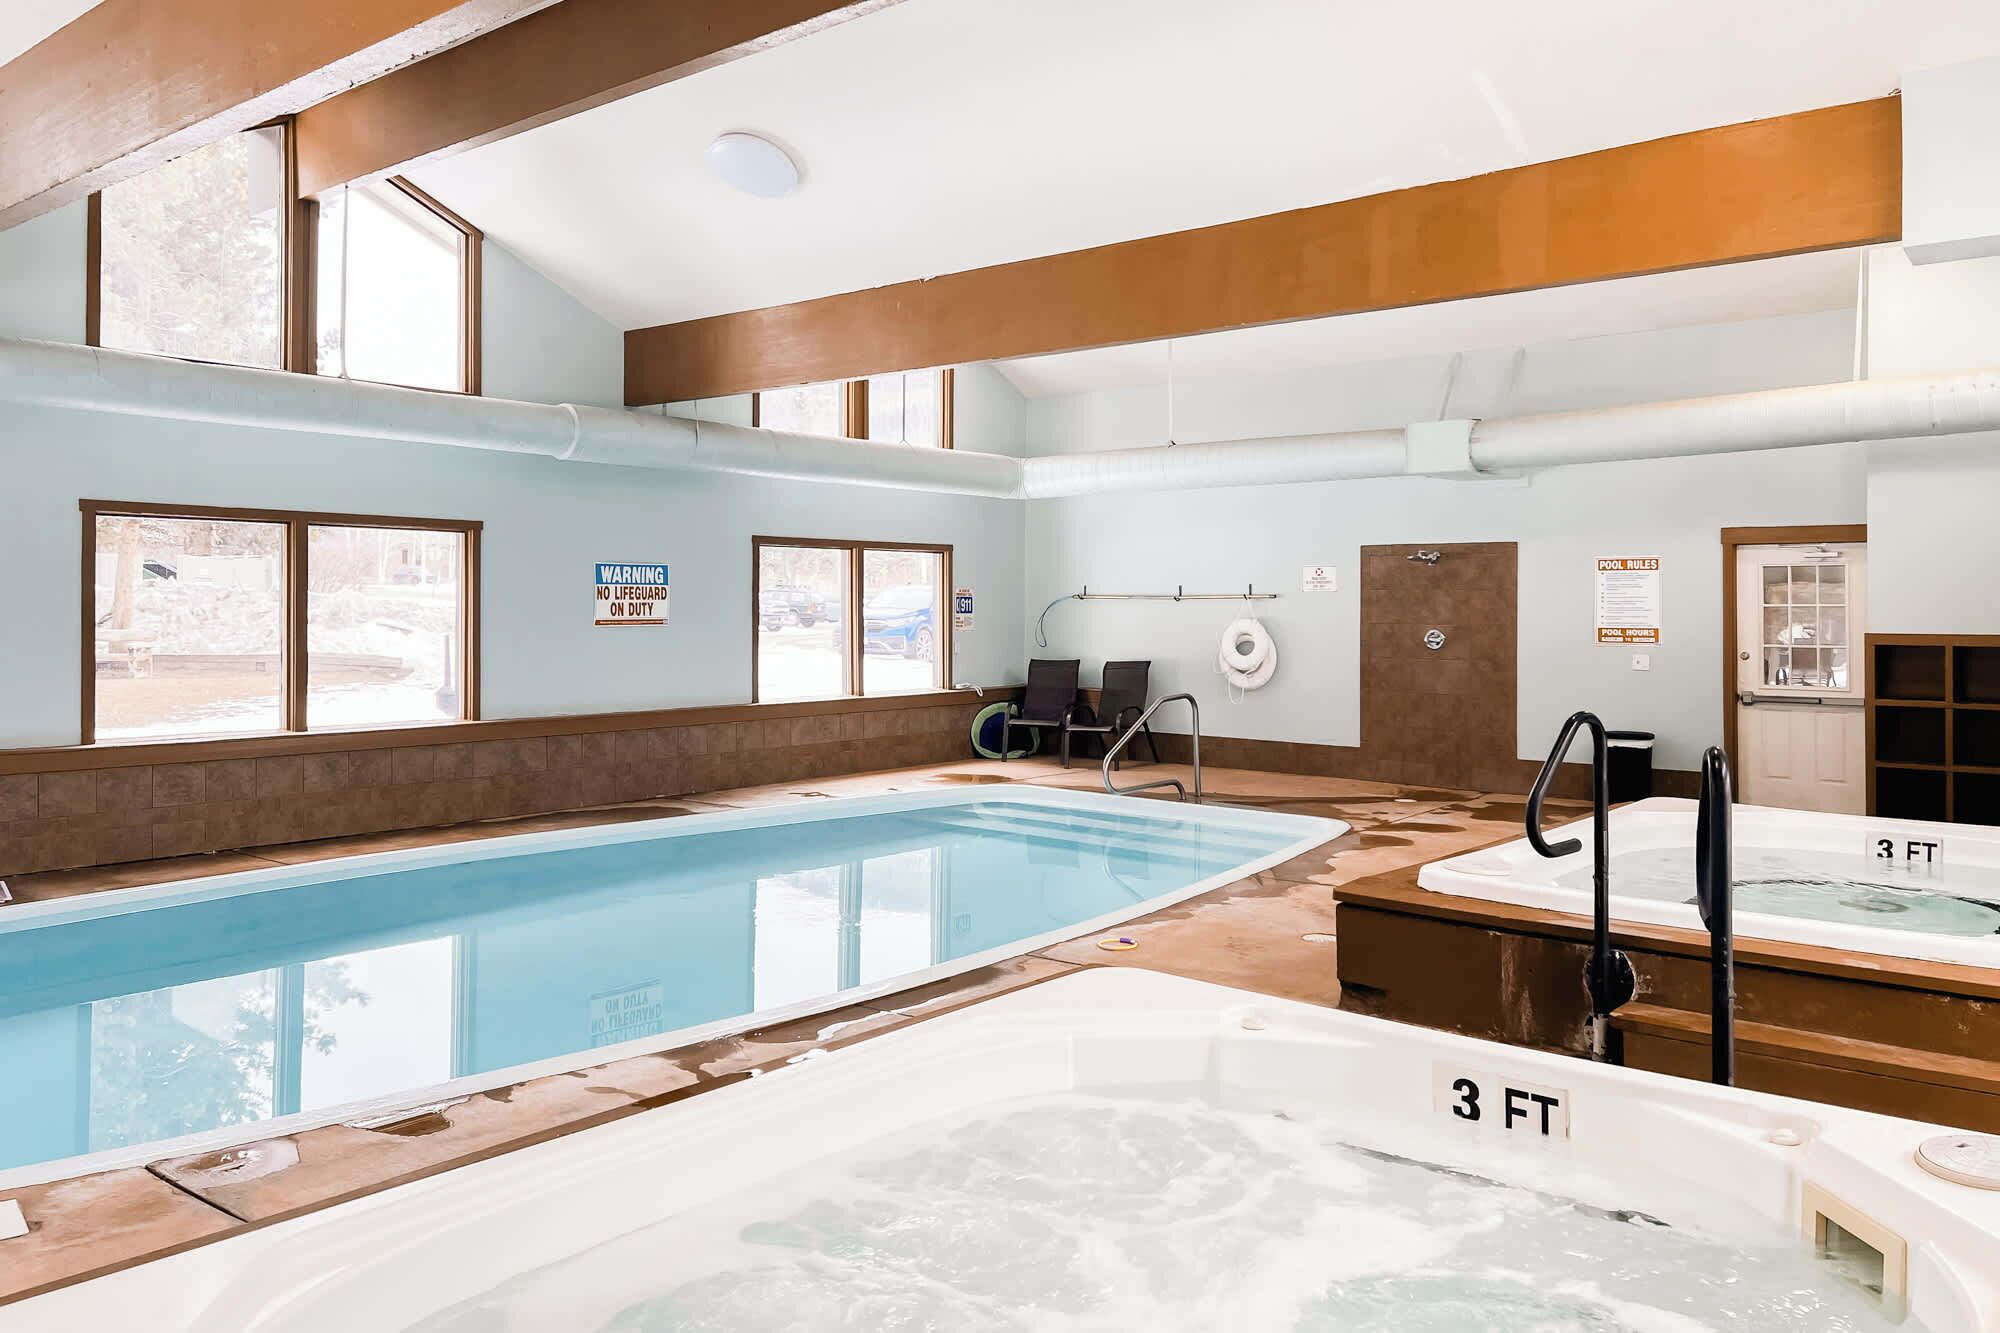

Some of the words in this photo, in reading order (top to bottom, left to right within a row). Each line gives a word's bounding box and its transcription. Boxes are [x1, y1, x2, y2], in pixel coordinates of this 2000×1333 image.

[1599, 560, 1624, 570] POOL
[1627, 560, 1657, 570] RULES
[600, 565, 664, 584] WARNING
[596, 586, 610, 600] NO
[614, 586, 667, 600] LIFEGUARD
[610, 602, 624, 616] ON
[628, 602, 653, 616] DUTY
[960, 598, 972, 612] 911
[1602, 628, 1623, 636] POOL
[1626, 629, 1655, 637] HOURS
[1877, 838, 1894, 858] 3
[1907, 840, 1938, 862] FT
[1452, 1078, 1481, 1122] 3
[1504, 1087, 1559, 1136] FT
